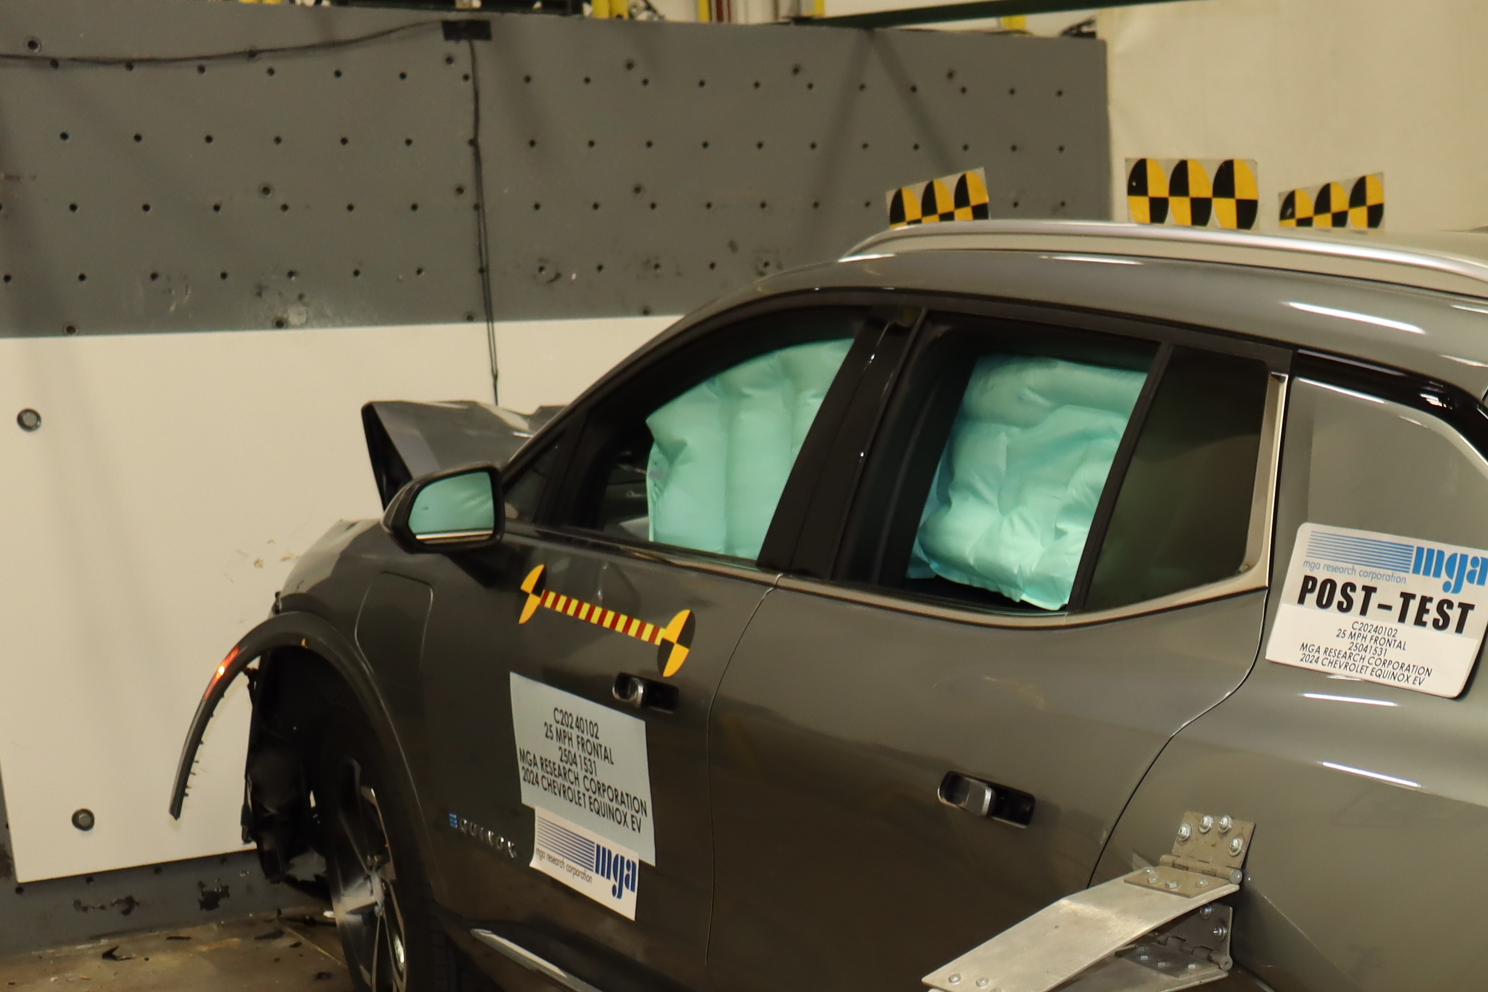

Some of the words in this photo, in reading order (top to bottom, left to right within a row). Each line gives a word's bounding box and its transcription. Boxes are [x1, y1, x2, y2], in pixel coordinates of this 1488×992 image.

[1303, 560, 1321, 571] mga
[1323, 563, 1357, 577] research
[1358, 569, 1407, 584] corporation
[1297, 575, 1476, 634] POST-TEST
[1336, 628, 1346, 639] 25
[1347, 630, 1368, 643] MPH
[1369, 635, 1407, 651] FRONTAL
[1351, 620, 1398, 638] C20240102
[1300, 642, 1321, 654] MGA
[1323, 647, 1366, 663] RESEARCH
[1367, 656, 1433, 677] CORPORATION
[1348, 641, 1388, 658] 25041531
[1300, 653, 1320, 665] 2024
[1321, 657, 1369, 675] CHEVROLET
[1370, 668, 1412, 684] EQUINOX
[1412, 676, 1426, 686] EV
[553, 707, 600, 740] C20240102
[544, 721, 554, 741] 25
[555, 727, 574, 748] MPH
[576, 734, 614, 765] FRONTAL
[558, 746, 598, 777] 25041531
[519, 747, 539, 770] MGA
[540, 755, 580, 787] RESEARCH
[583, 775, 648, 818] CORPORATION
[521, 766, 540, 788] 2024
[540, 775, 587, 808] CHEVROLET
[588, 795, 629, 828] EQUINOX
[630, 814, 642, 833] EV
[536, 848, 545, 861] mga
[546, 853, 565, 869] research
[566, 863, 593, 884] corporation
[595, 843, 637, 900] mga
